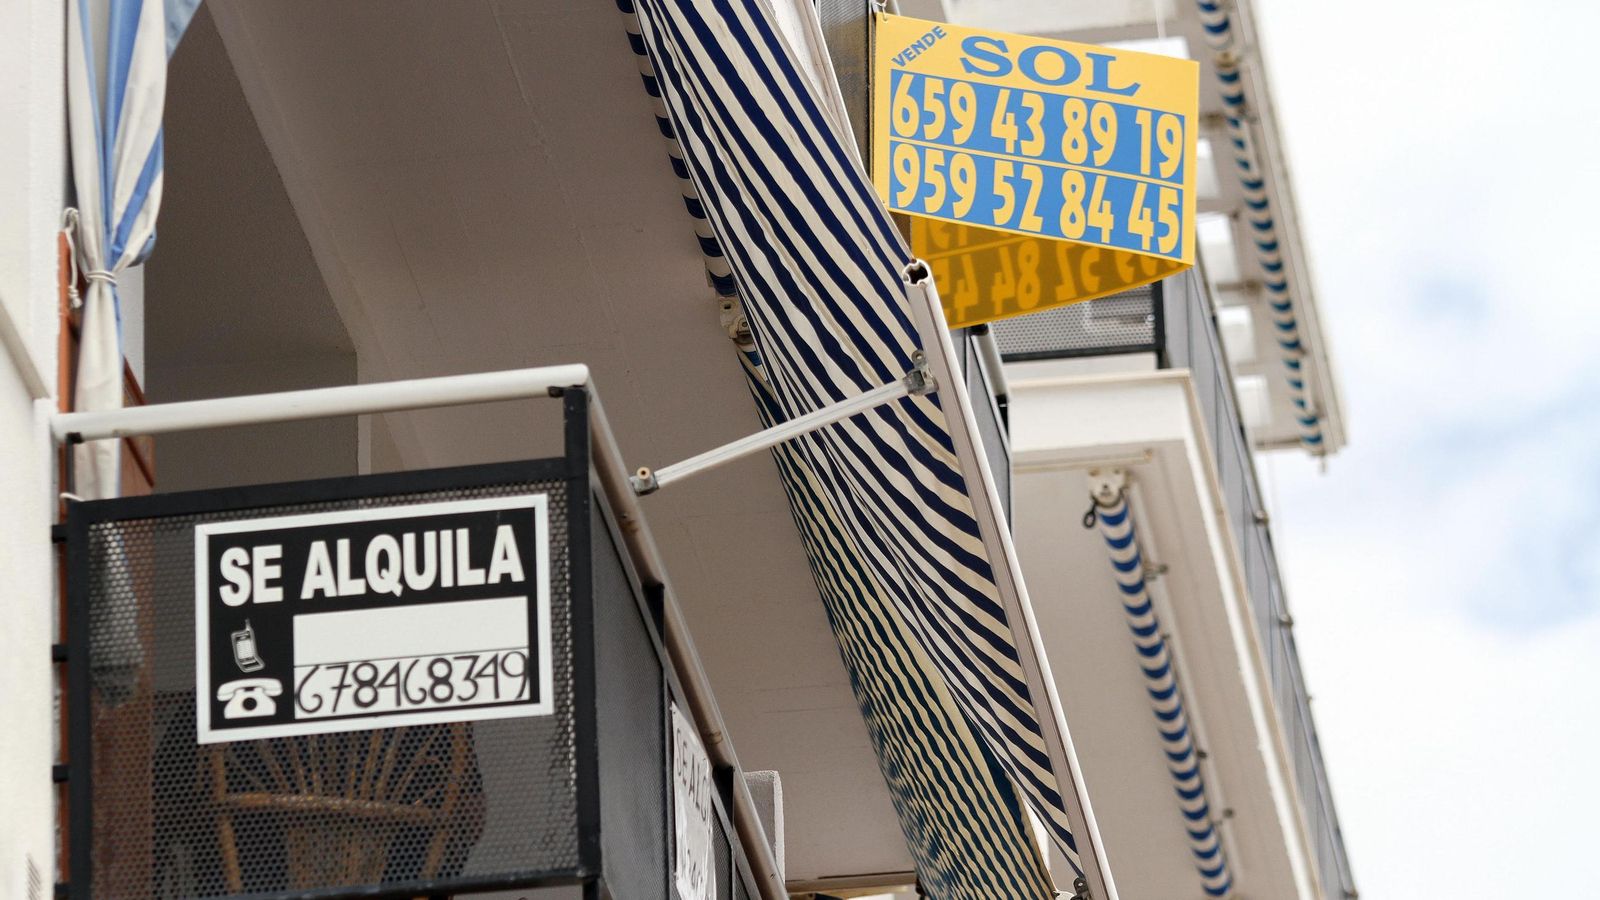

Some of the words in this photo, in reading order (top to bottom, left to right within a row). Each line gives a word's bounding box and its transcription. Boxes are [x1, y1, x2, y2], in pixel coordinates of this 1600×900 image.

[891, 26, 947, 67] VENDE
[960, 35, 1141, 97] SOL
[892, 73, 977, 145] 659
[991, 88, 1045, 157] 43
[1061, 97, 1118, 167] 89
[1135, 109, 1183, 179] 19
[893, 143, 977, 219] 959
[993, 159, 1044, 233] 52
[1060, 170, 1114, 243] 84
[1127, 182, 1179, 254] 45
[218, 544, 284, 607] SE
[300, 525, 525, 598] ALQUILA
[294, 650, 529, 714] 678468349
[676, 727, 688, 787] SE
